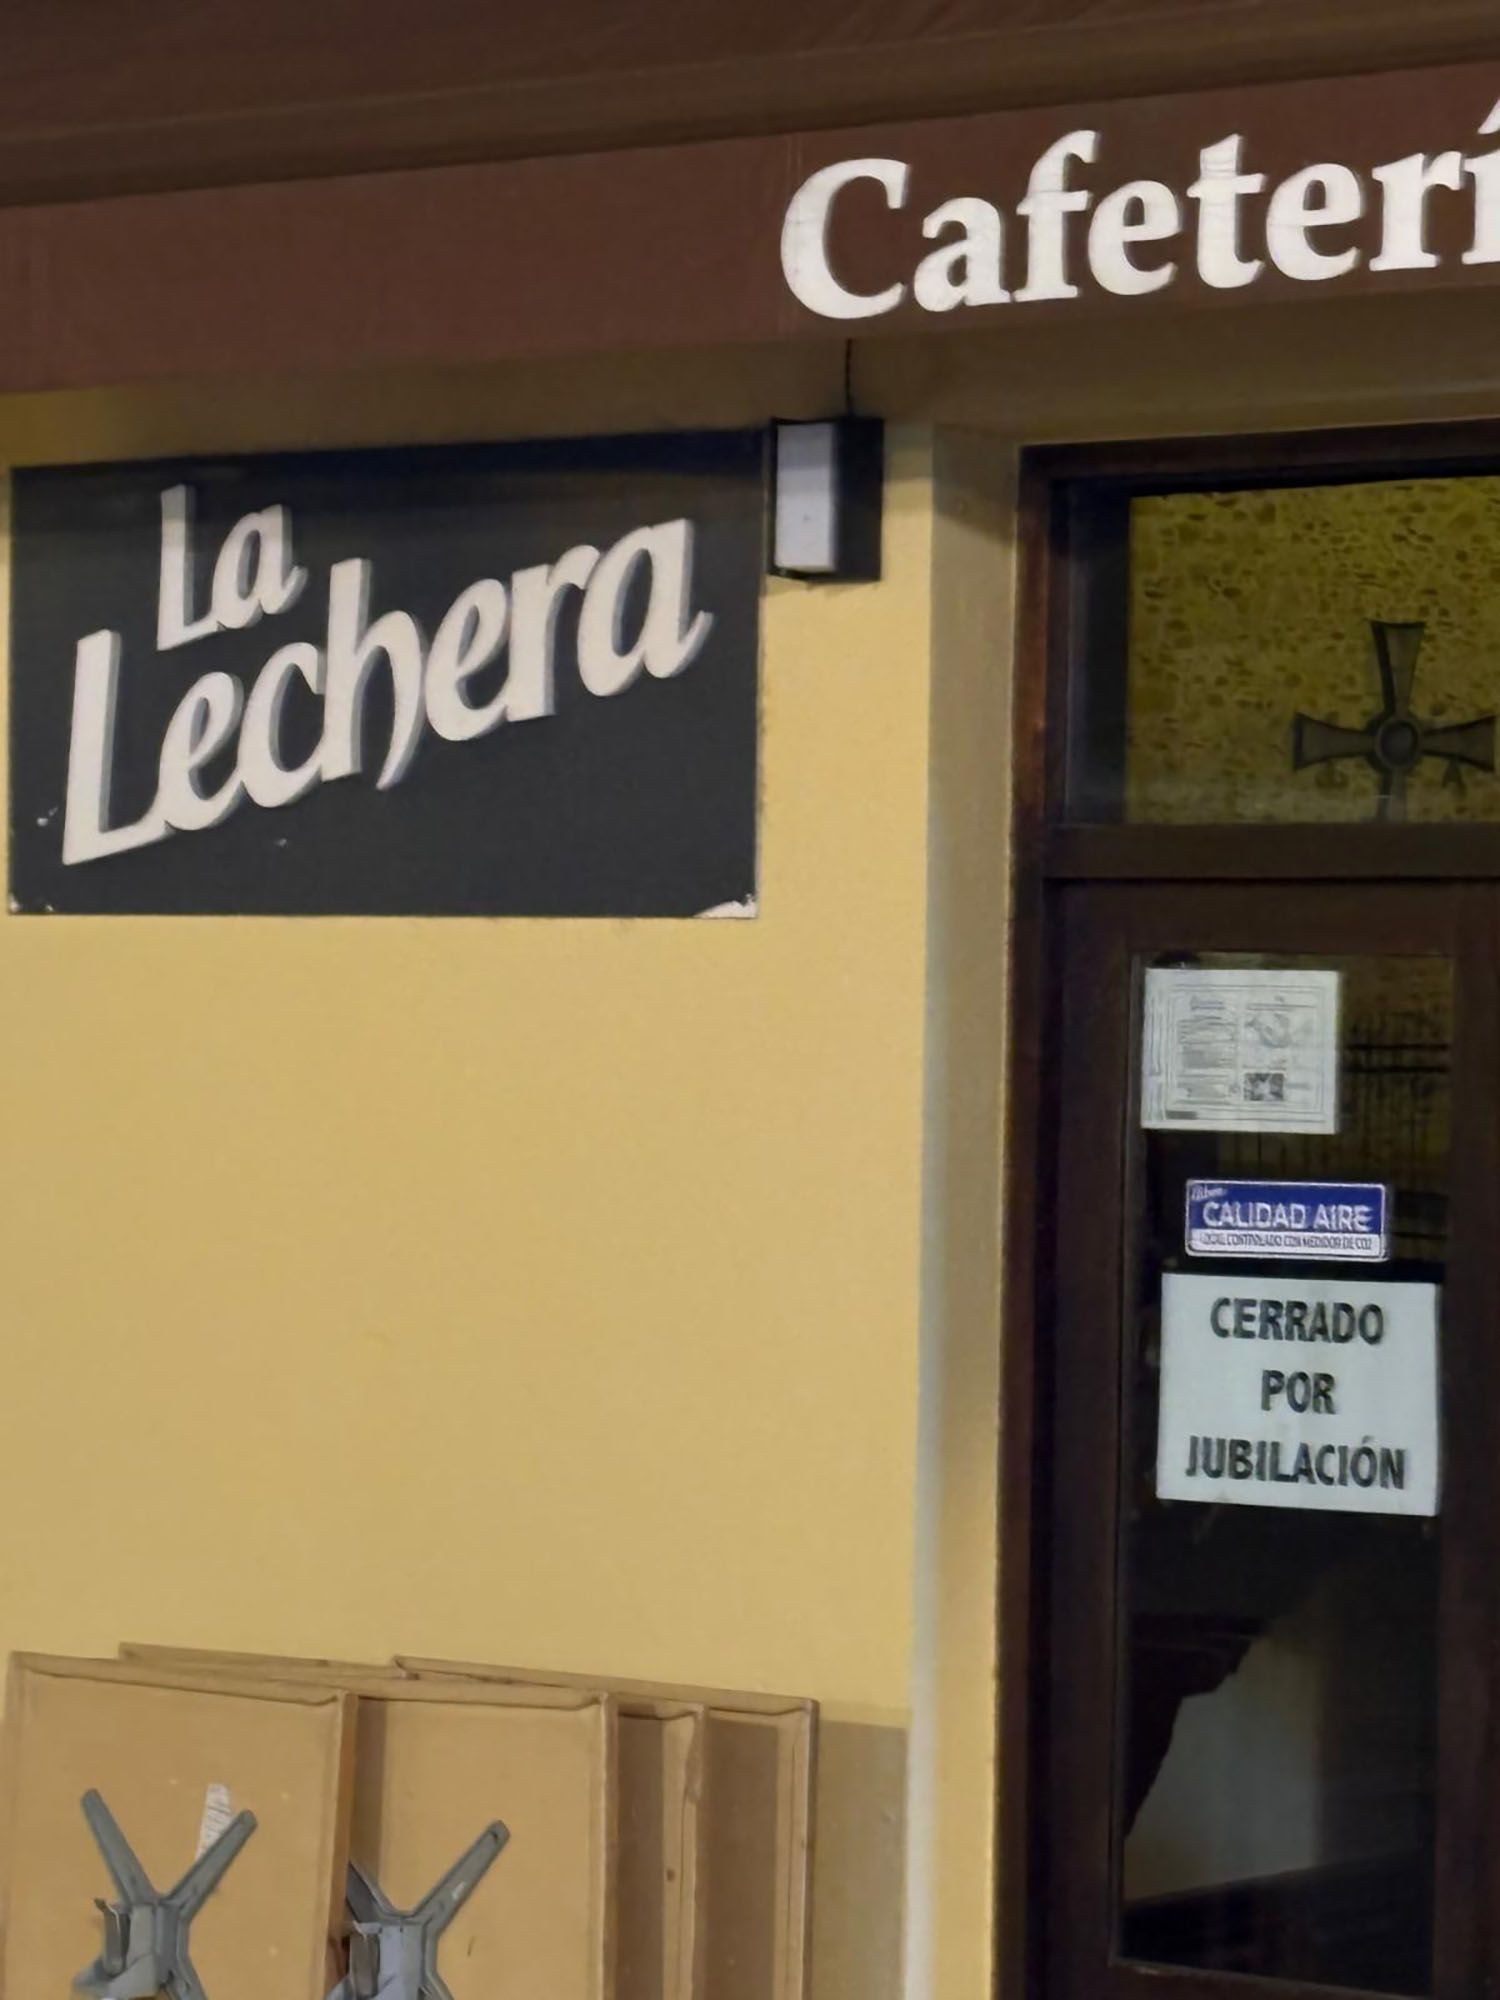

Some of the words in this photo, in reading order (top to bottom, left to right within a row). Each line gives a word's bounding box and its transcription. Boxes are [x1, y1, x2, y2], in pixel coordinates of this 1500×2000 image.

[157, 484, 308, 650] La
[62, 517, 714, 866] Lechera
[1202, 1200, 1307, 1229] CALIDAD
[1313, 1204, 1375, 1232] AIRE
[1210, 1297, 1384, 1345] CERRADO
[1261, 1369, 1337, 1414] POR
[1185, 1435, 1406, 1490] JUBILACIÓN
